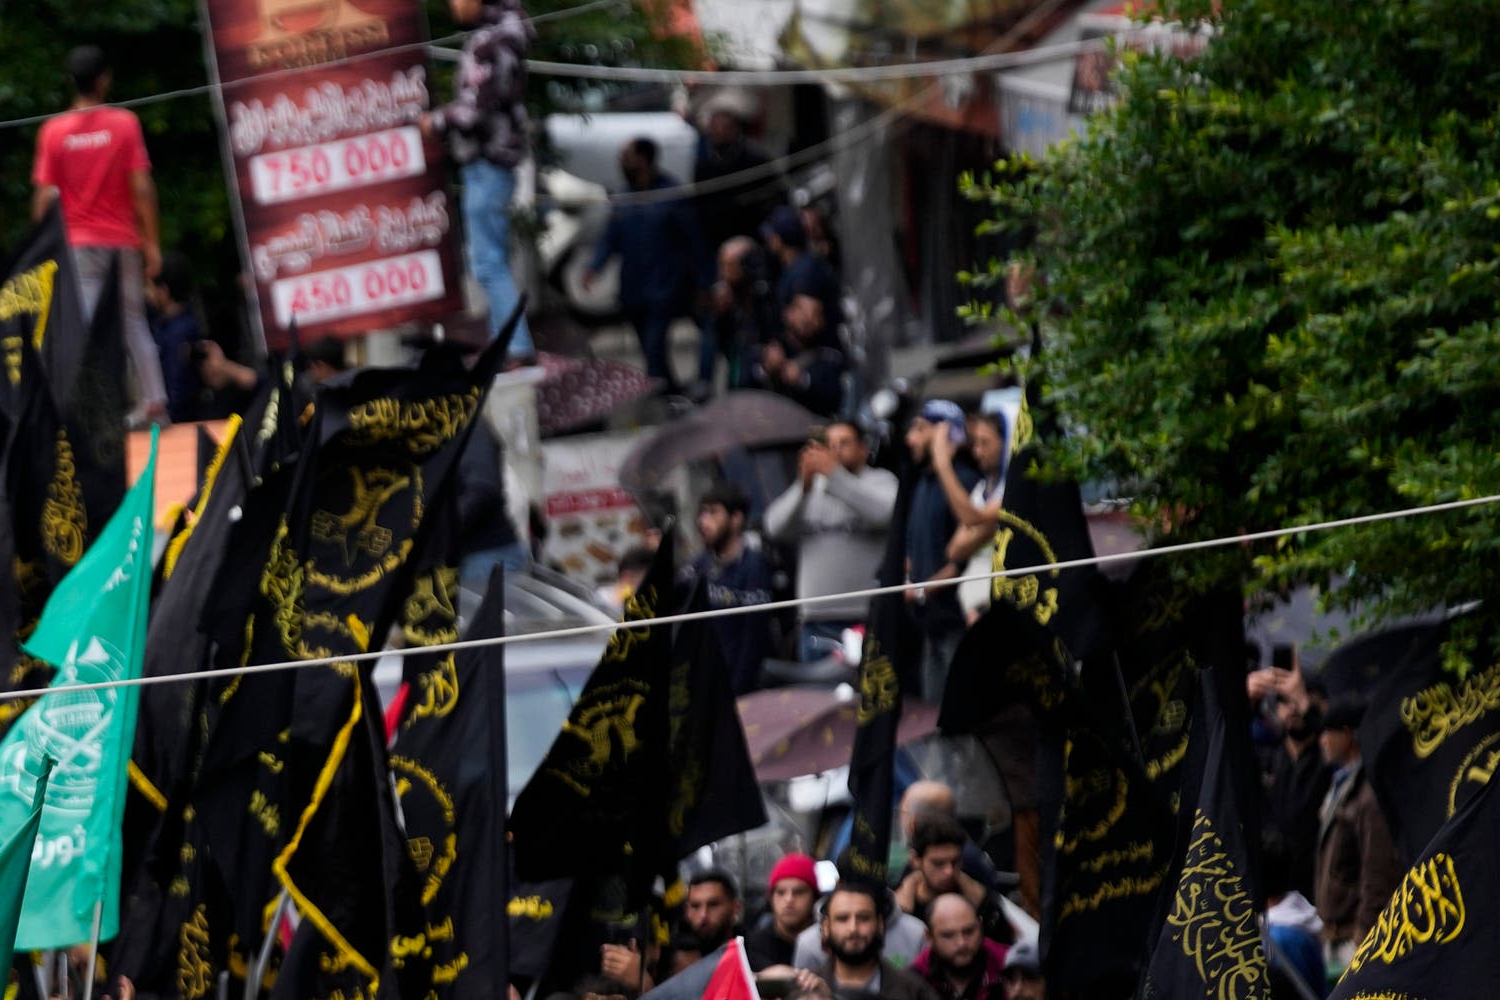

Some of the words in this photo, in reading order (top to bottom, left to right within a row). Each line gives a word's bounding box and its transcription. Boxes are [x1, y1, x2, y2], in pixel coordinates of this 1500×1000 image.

[264, 147, 332, 194] 750
[344, 134, 411, 182] 000
[290, 272, 351, 313] 450
[365, 258, 428, 301] 000
